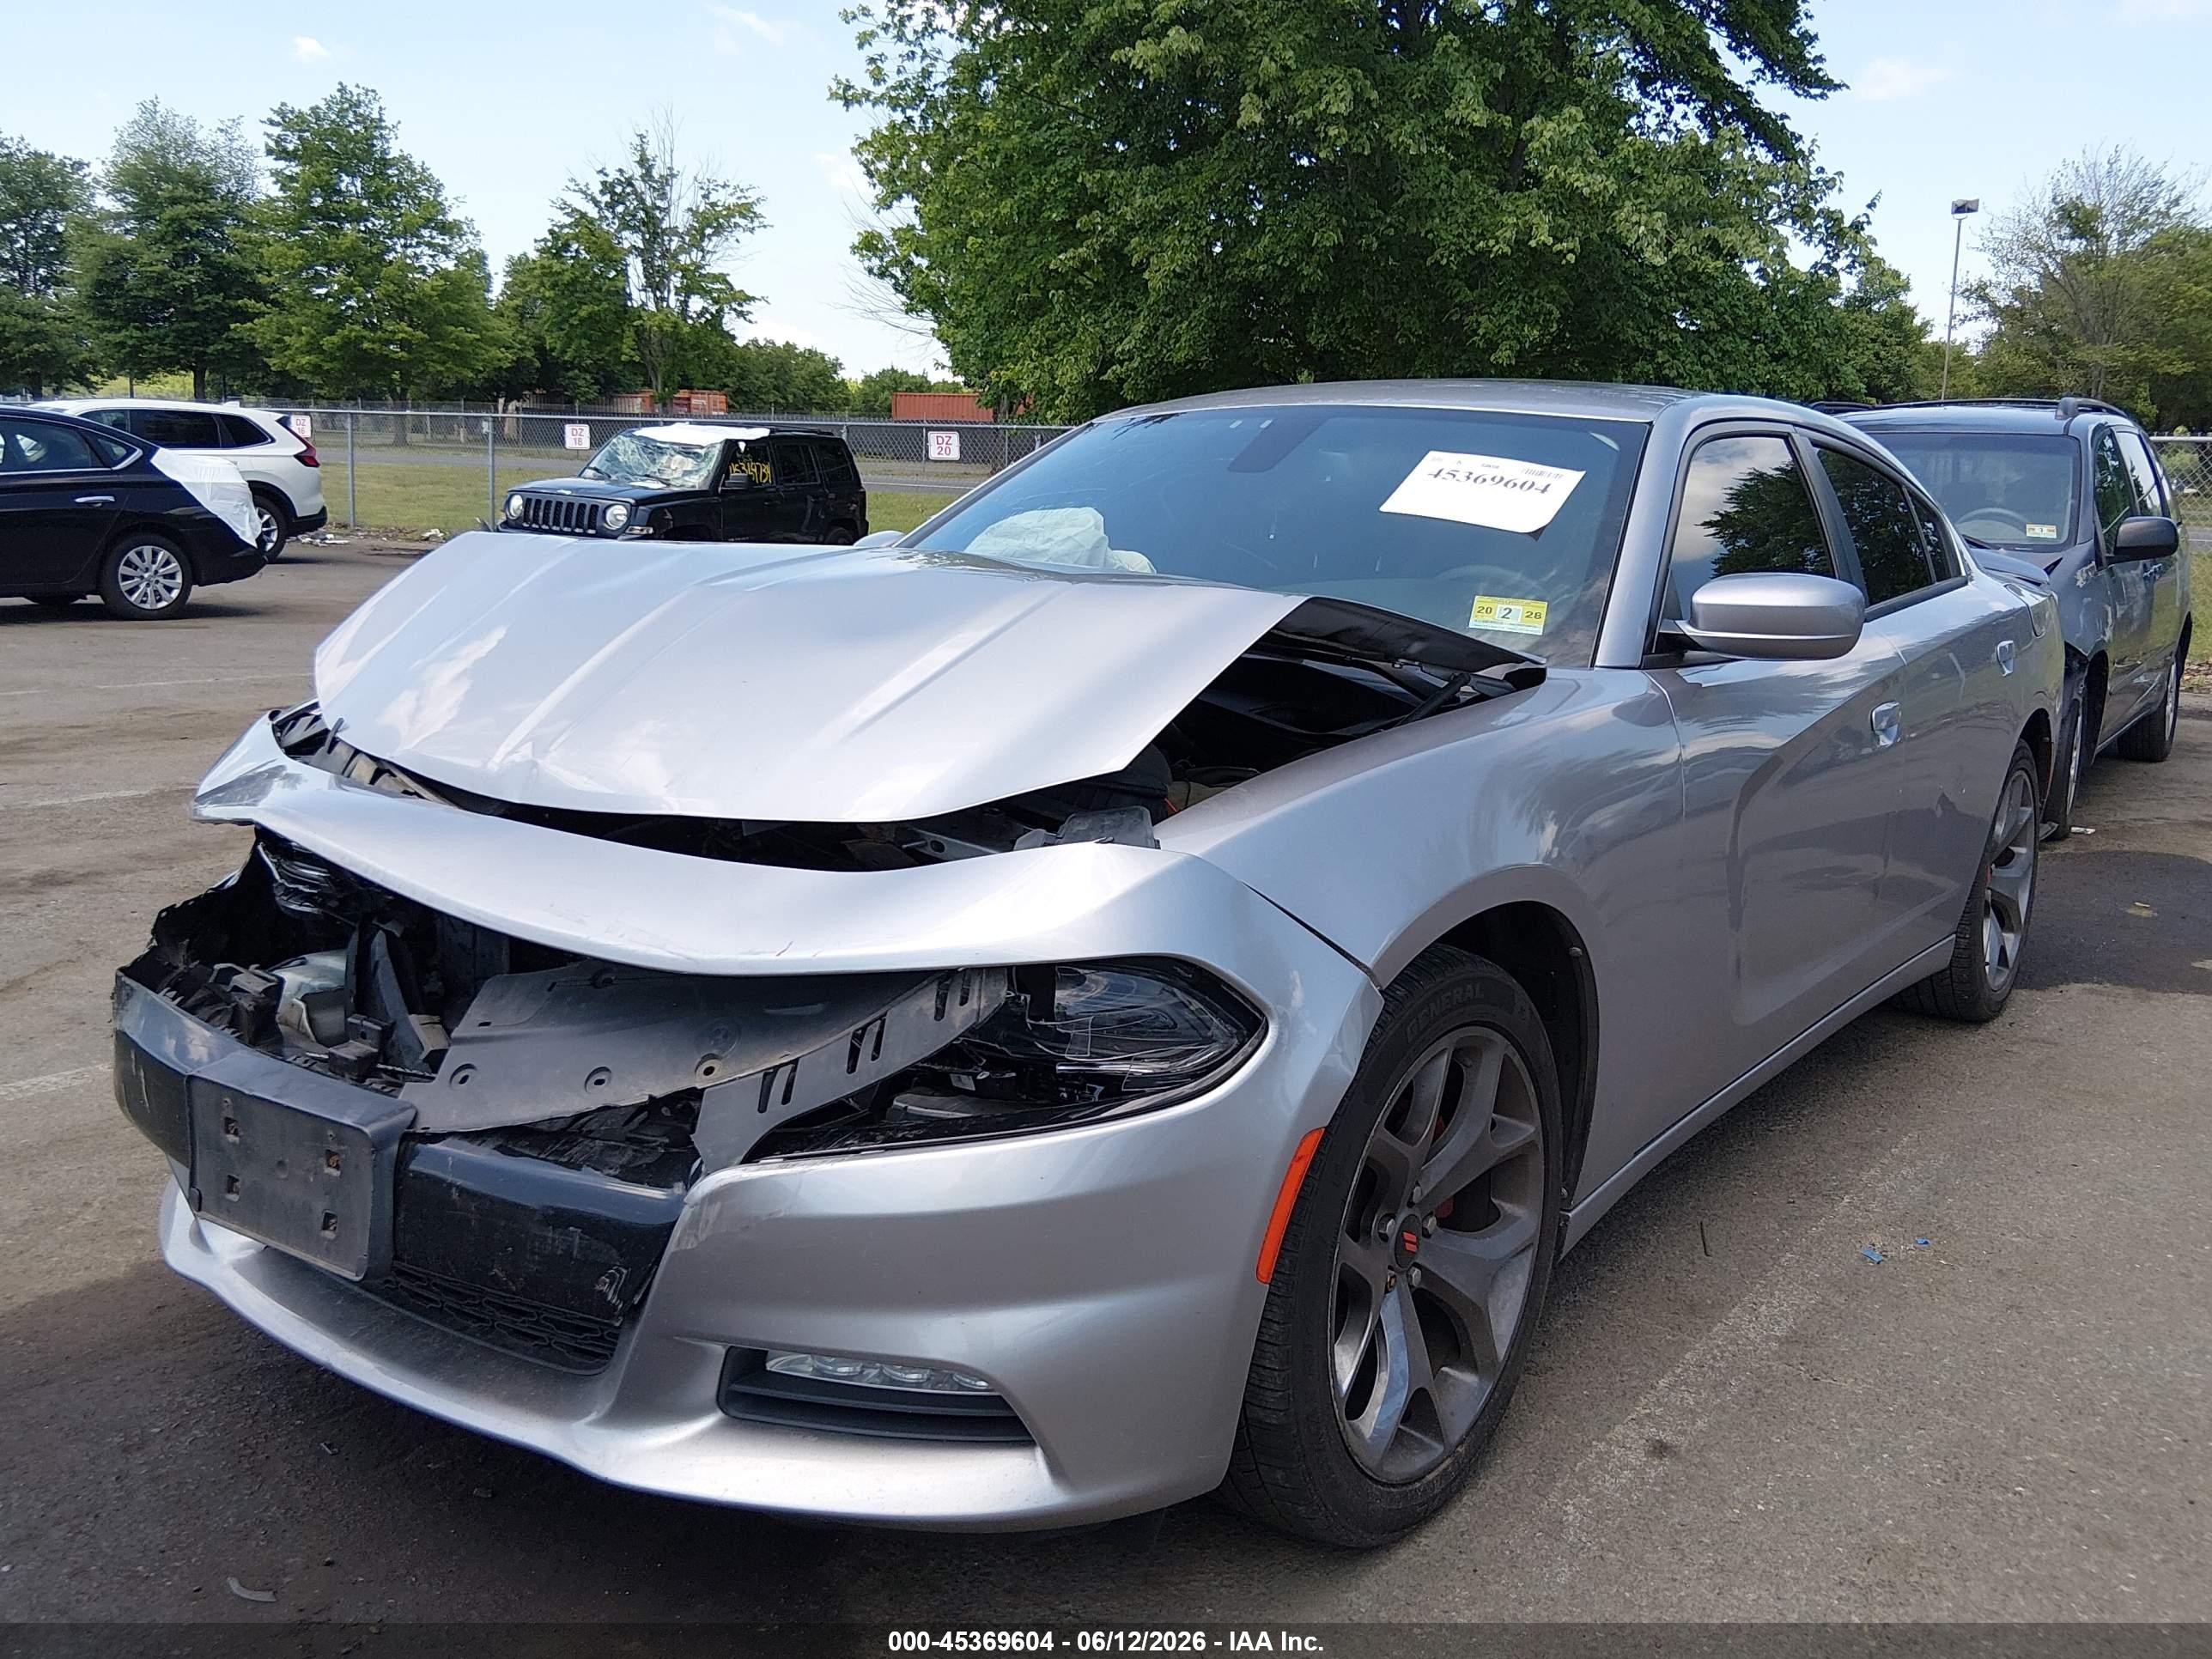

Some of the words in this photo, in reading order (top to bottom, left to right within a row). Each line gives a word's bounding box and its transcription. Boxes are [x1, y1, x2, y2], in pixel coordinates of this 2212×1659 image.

[295, 418, 307, 427] DZ
[571, 428, 585, 436] DZ
[573, 437, 583, 446] 18
[936, 435, 952, 446] DZ
[937, 446, 951, 456] 20
[1427, 467, 1552, 495] 45369604
[1476, 605, 1493, 615] 20
[1501, 607, 1513, 620] 2
[1524, 611, 1543, 620] 28
[1407, 982, 1485, 1044] GENERAL
